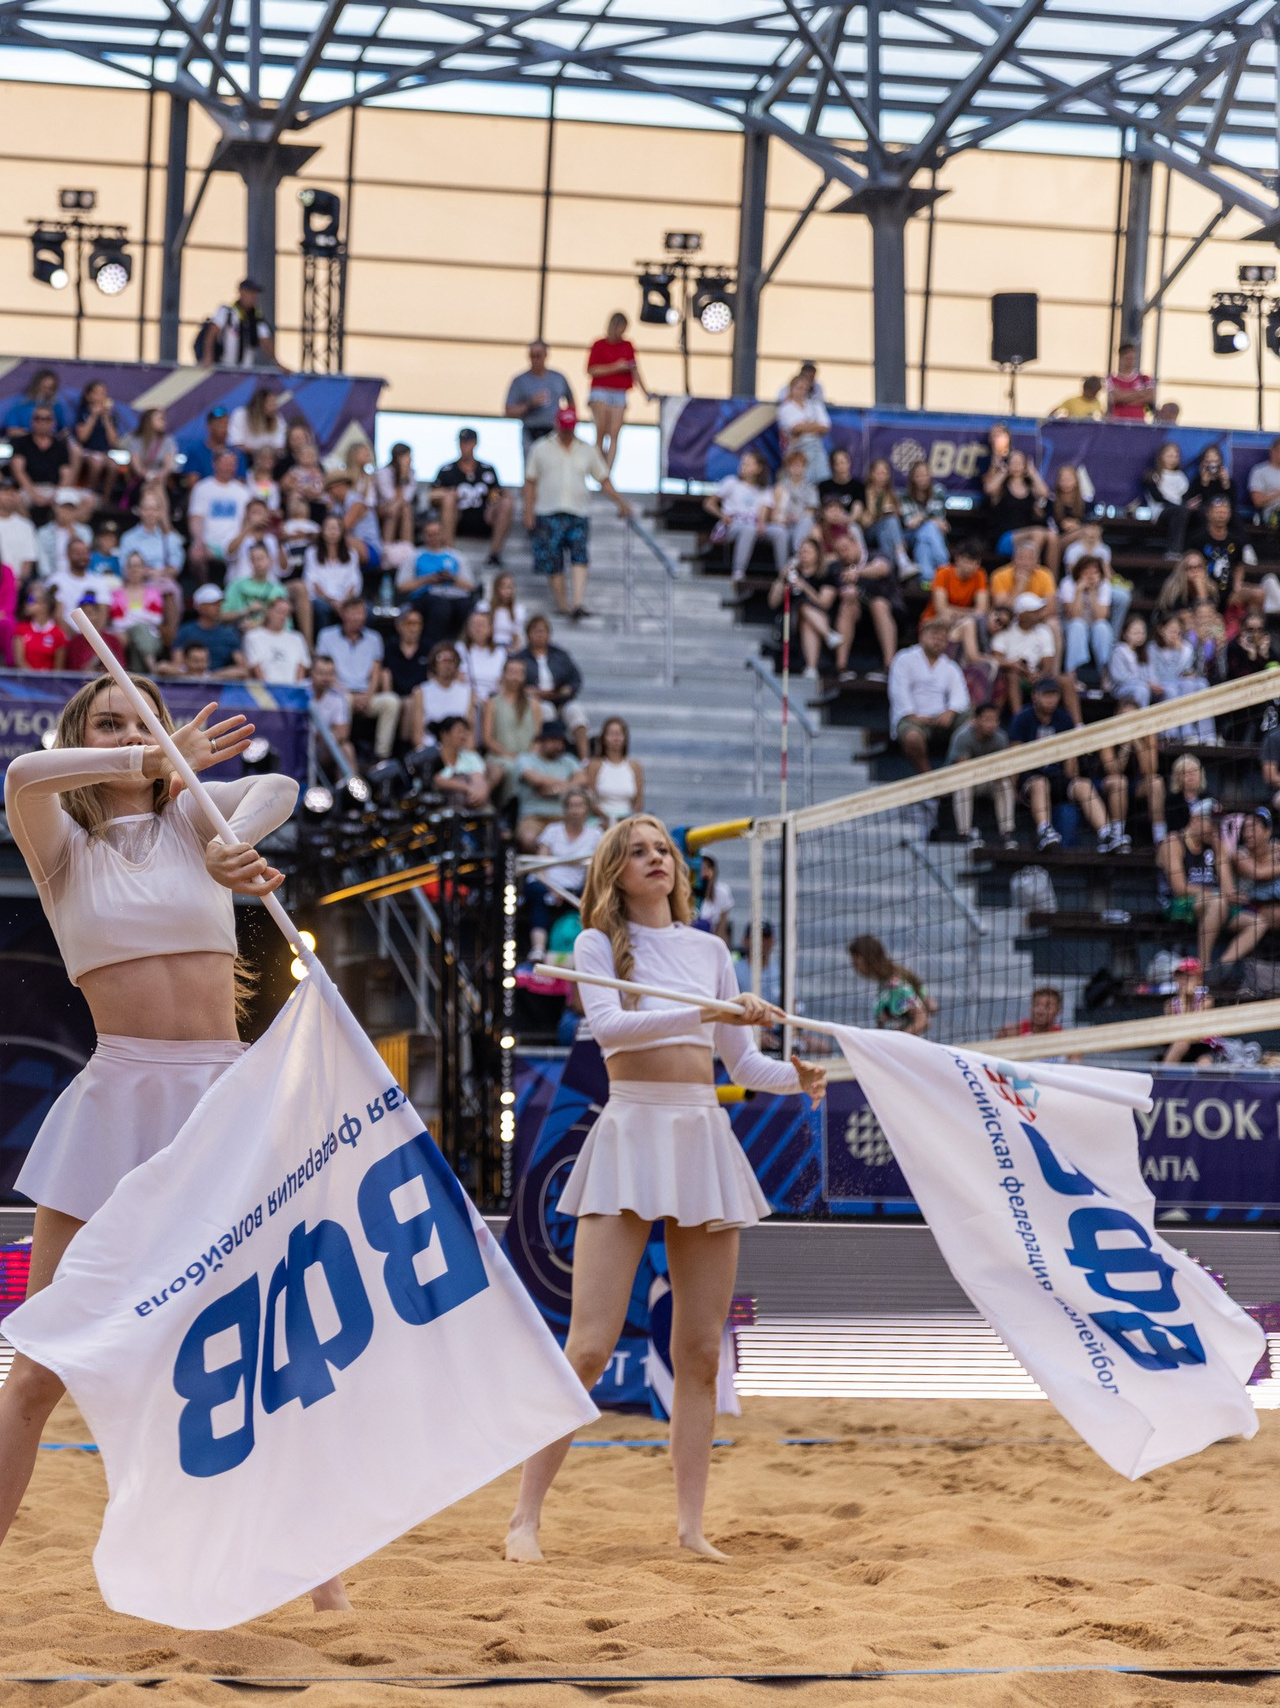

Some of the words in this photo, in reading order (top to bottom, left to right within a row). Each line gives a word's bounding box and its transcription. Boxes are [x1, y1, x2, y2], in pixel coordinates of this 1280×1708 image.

[267, 1113, 361, 1216] федерация
[1134, 1097, 1264, 1141] УБОК
[1140, 1155, 1200, 1182] АПА
[134, 1203, 263, 1318] волейбола
[173, 1131, 490, 1479] ВФВ
[999, 1176, 1053, 1291] федерация
[1054, 1296, 1119, 1395] олейбол
